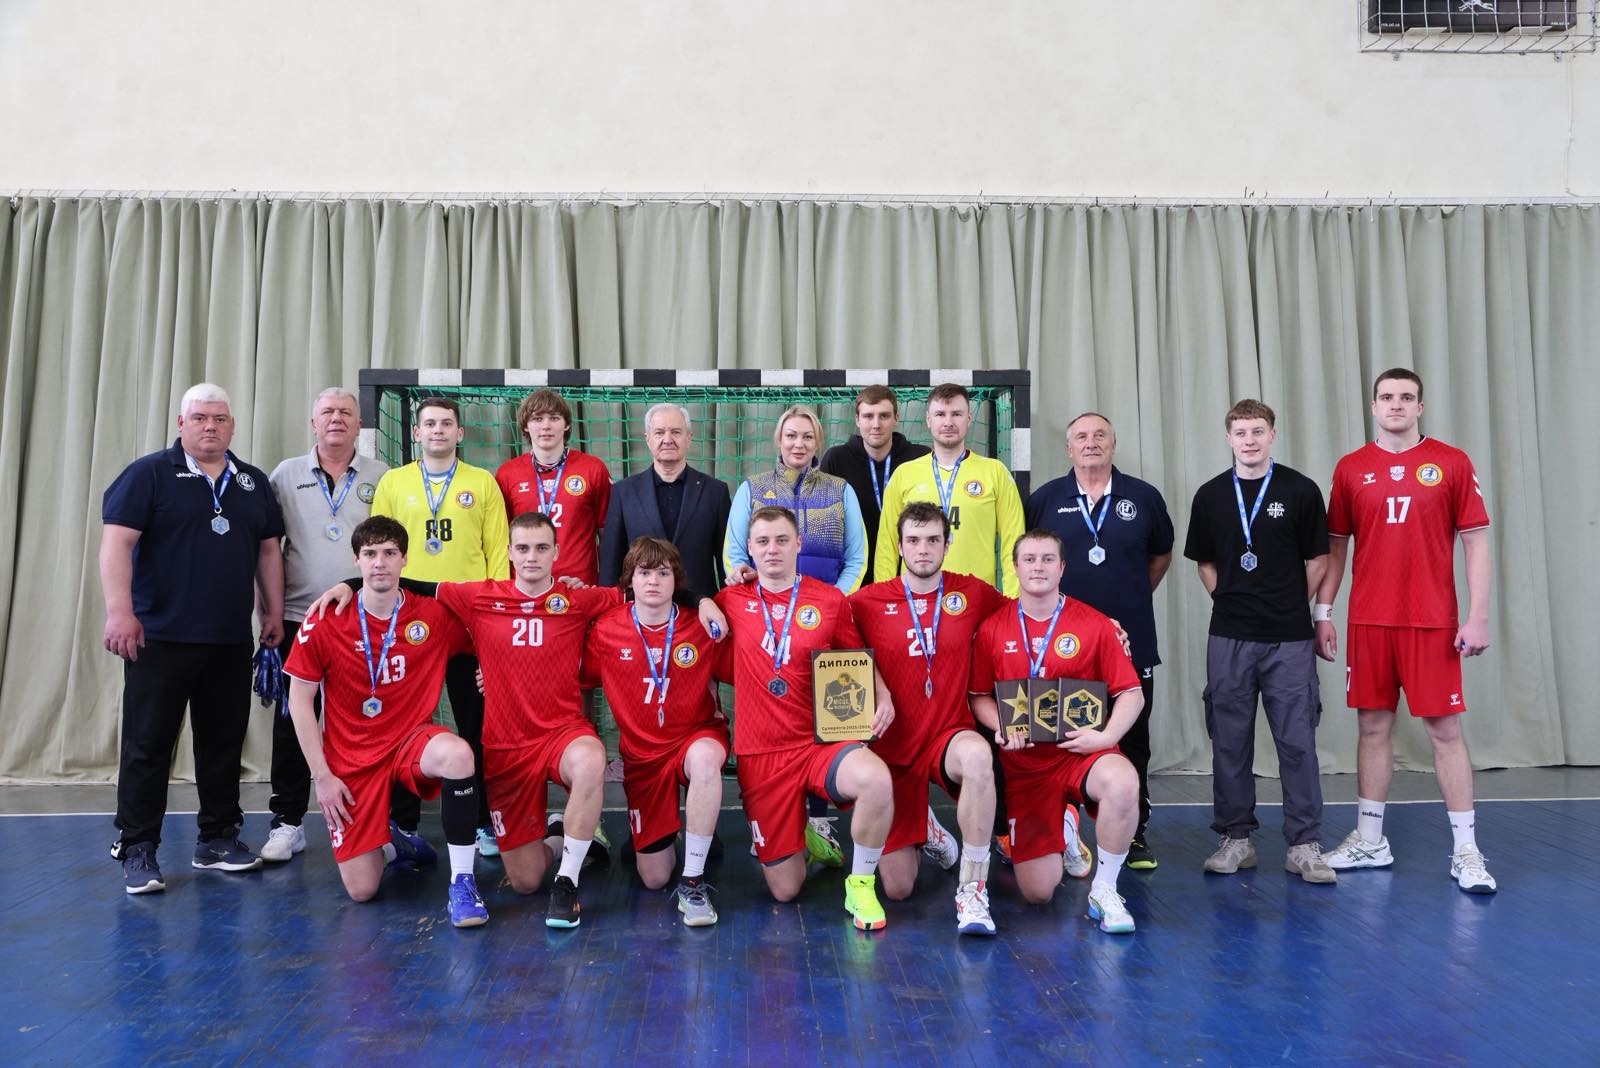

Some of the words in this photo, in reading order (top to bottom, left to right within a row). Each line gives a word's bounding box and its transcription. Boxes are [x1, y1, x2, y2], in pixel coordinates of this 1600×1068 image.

[538, 503, 563, 528] 2
[1386, 496, 1411, 524] 17
[425, 518, 452, 542] 88
[512, 618, 543, 647] 20
[906, 627, 936, 657] 21
[380, 655, 406, 685] 13
[818, 659, 868, 669] ДИПЛОМ
